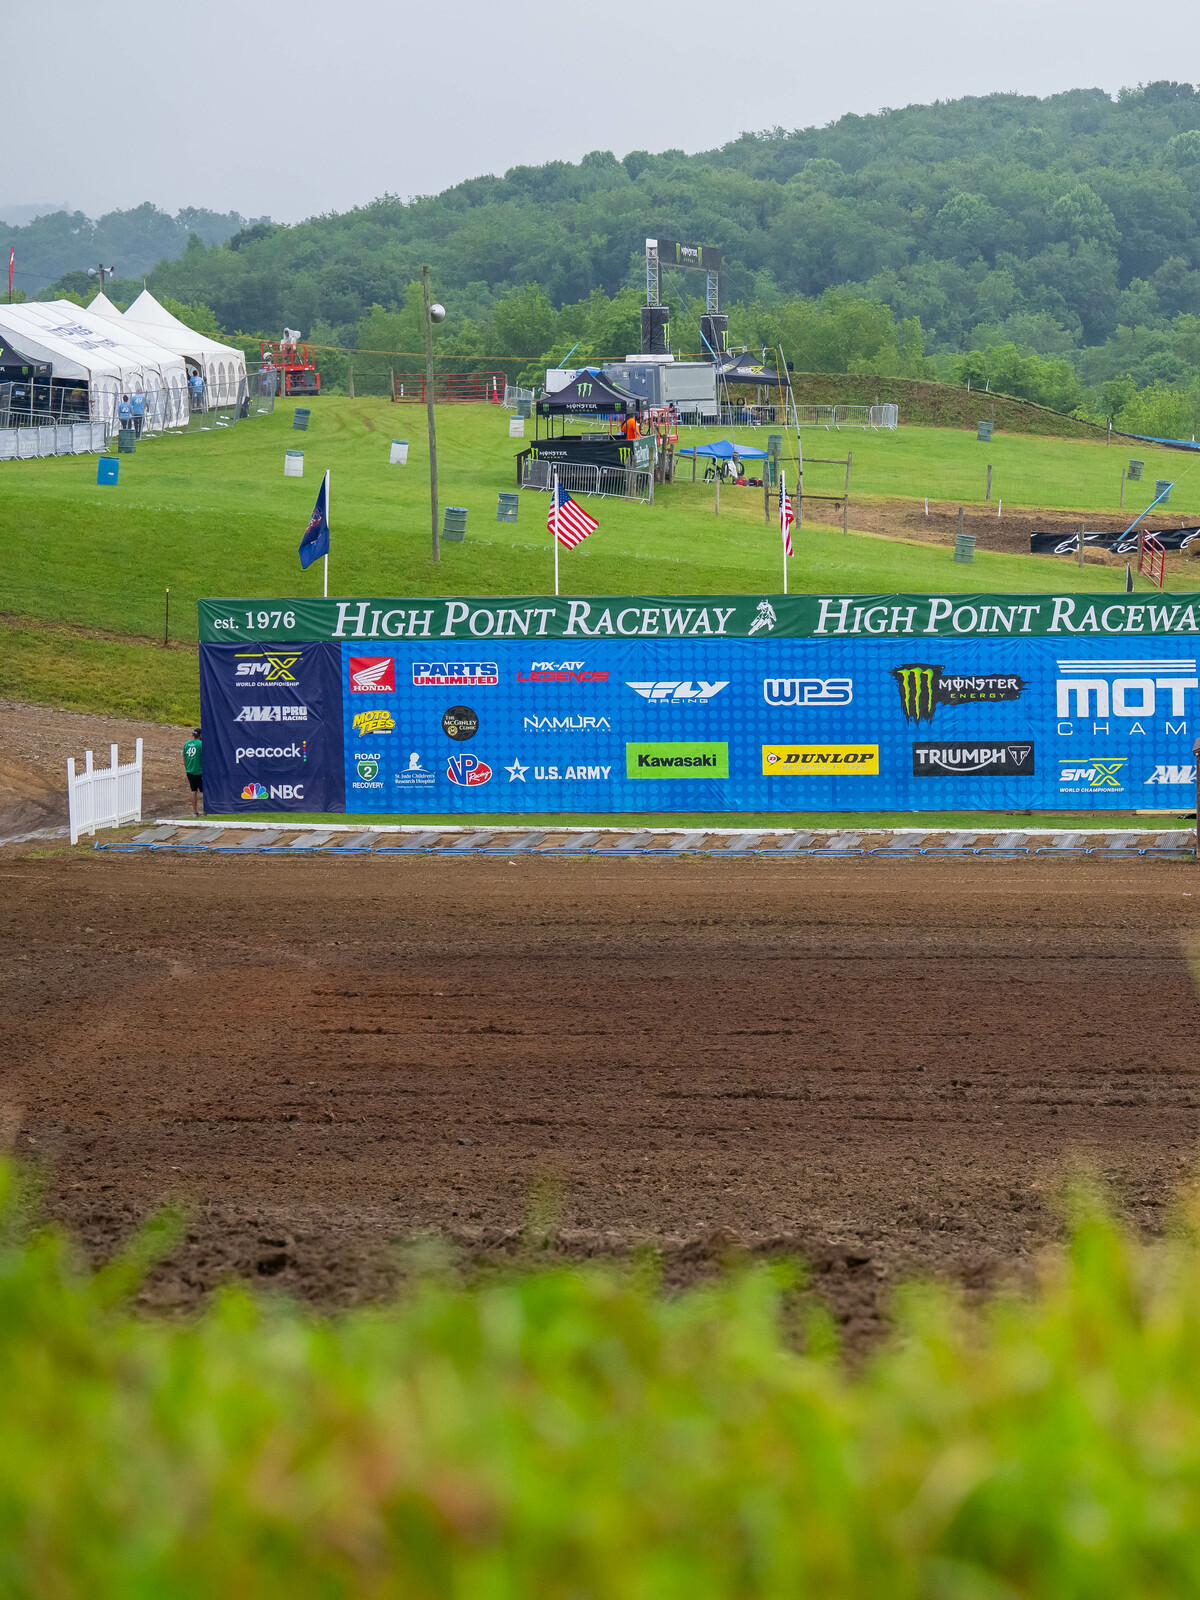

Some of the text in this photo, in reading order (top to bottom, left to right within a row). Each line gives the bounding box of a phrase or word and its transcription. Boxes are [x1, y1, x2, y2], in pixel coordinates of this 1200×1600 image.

[214, 611, 296, 629] est. 1976
[332, 600, 736, 637] HIGH POINT RACEWAY
[813, 599, 917, 634] HIGH
[923, 598, 1040, 633] POINT
[235, 657, 298, 680] SMX
[413, 663, 498, 676] PARTS
[413, 676, 498, 685] UNLIMITED
[516, 671, 609, 684] LEGENDS
[938, 676, 1019, 692] MONSTER
[632, 681, 730, 698] FLY
[763, 678, 852, 706] WPS
[233, 705, 308, 722] AMA PRO
[353, 710, 391, 728] MOTO
[523, 713, 611, 728] NAMURA
[358, 719, 396, 736] TEES
[186, 747, 197, 757] 49
[235, 742, 301, 763] peacock
[638, 754, 717, 767] Kawasaki
[783, 753, 874, 763] DUNLOP
[916, 748, 1006, 768] TRIUMPH
[363, 766, 373, 778] 2
[448, 754, 478, 786] VP
[468, 771, 491, 782] Racing
[534, 766, 612, 780] U.S. ARMY
[1059, 763, 1123, 786] SMX
[270, 784, 304, 799] NBC
